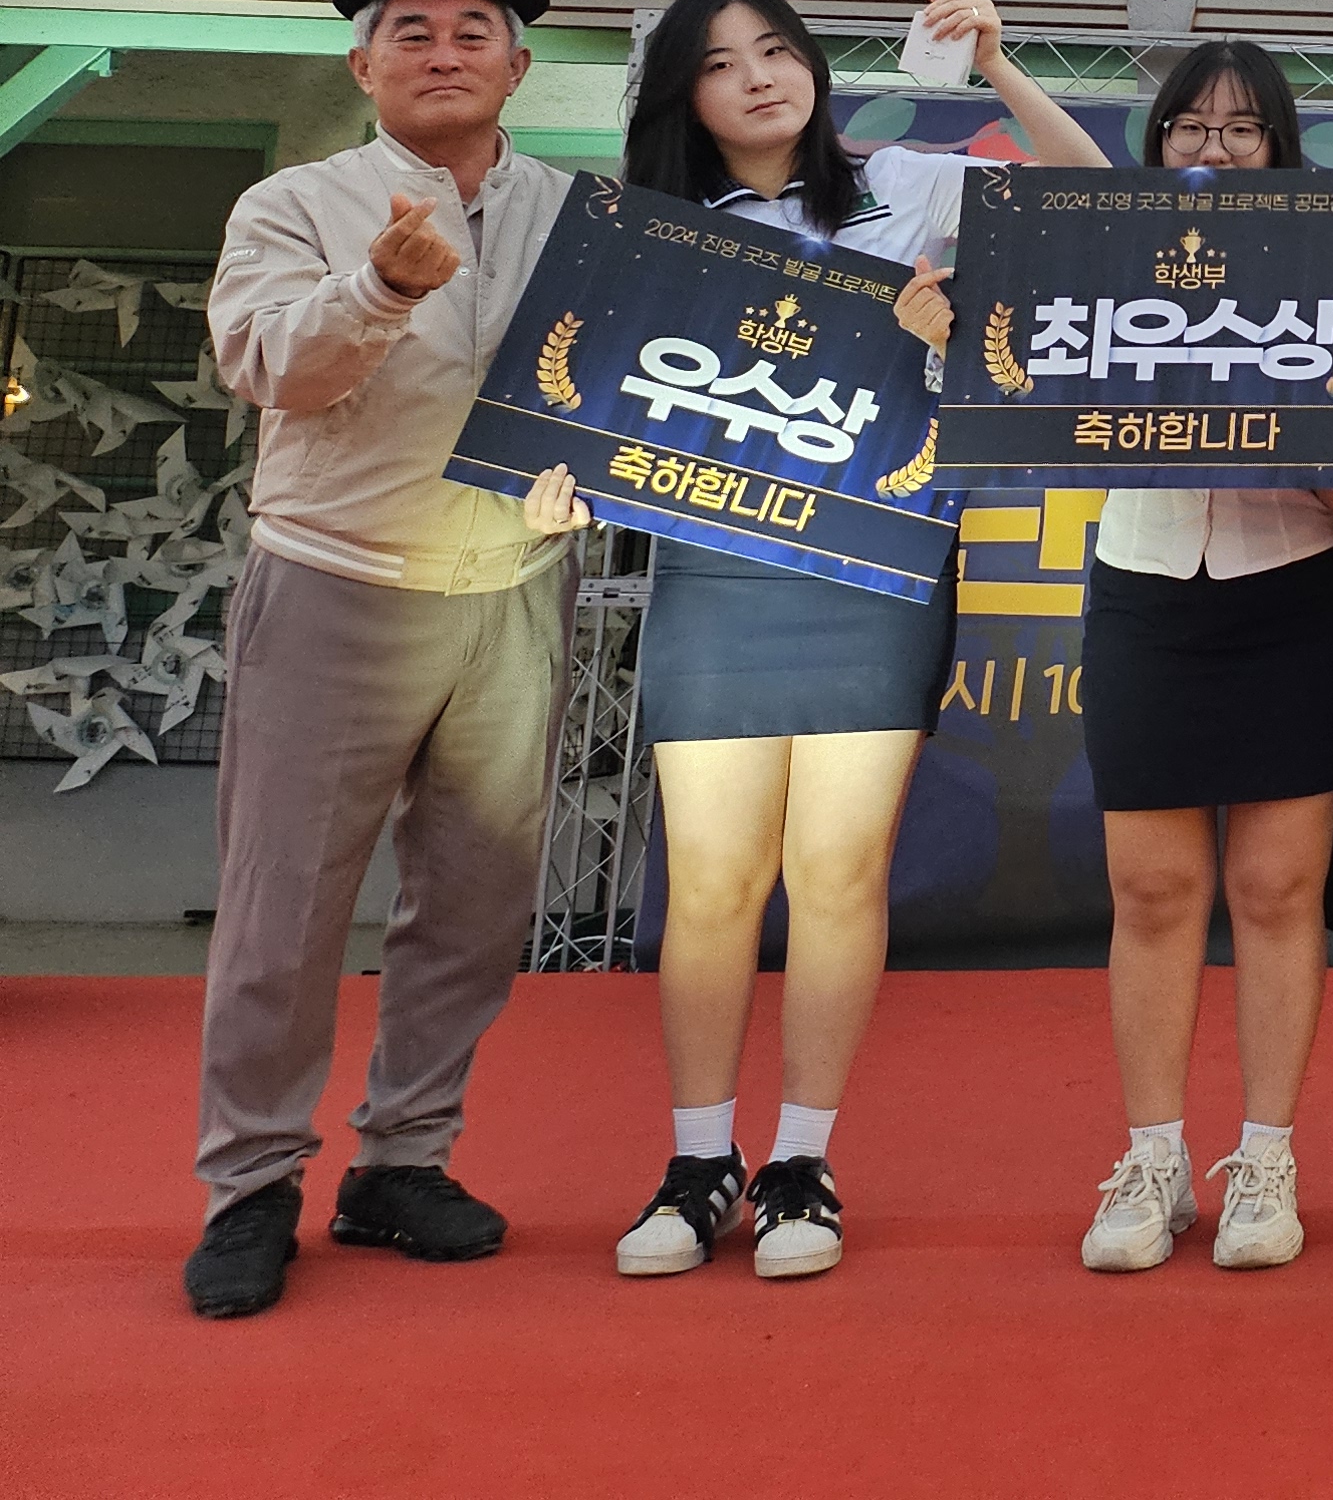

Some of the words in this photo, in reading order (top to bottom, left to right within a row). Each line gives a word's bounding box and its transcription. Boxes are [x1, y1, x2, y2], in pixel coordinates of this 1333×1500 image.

[1041, 191, 1092, 211] 2024
[1096, 191, 1132, 211] 진영
[1136, 192, 1173, 211] 굿즈
[1177, 192, 1214, 212] 발굴
[1217, 193, 1289, 212] 프로젝트
[644, 218, 699, 247] 2024
[701, 233, 742, 259] 진영
[742, 244, 782, 271] 굿즈
[783, 257, 823, 284] 발굴
[822, 269, 898, 305] 프로젝트
[1154, 262, 1227, 290] 학생부
[736, 317, 815, 361] 학생부
[619, 336, 881, 464] 우수상
[1072, 410, 1281, 452] 축하합니다
[608, 443, 817, 533] 축하합니다
